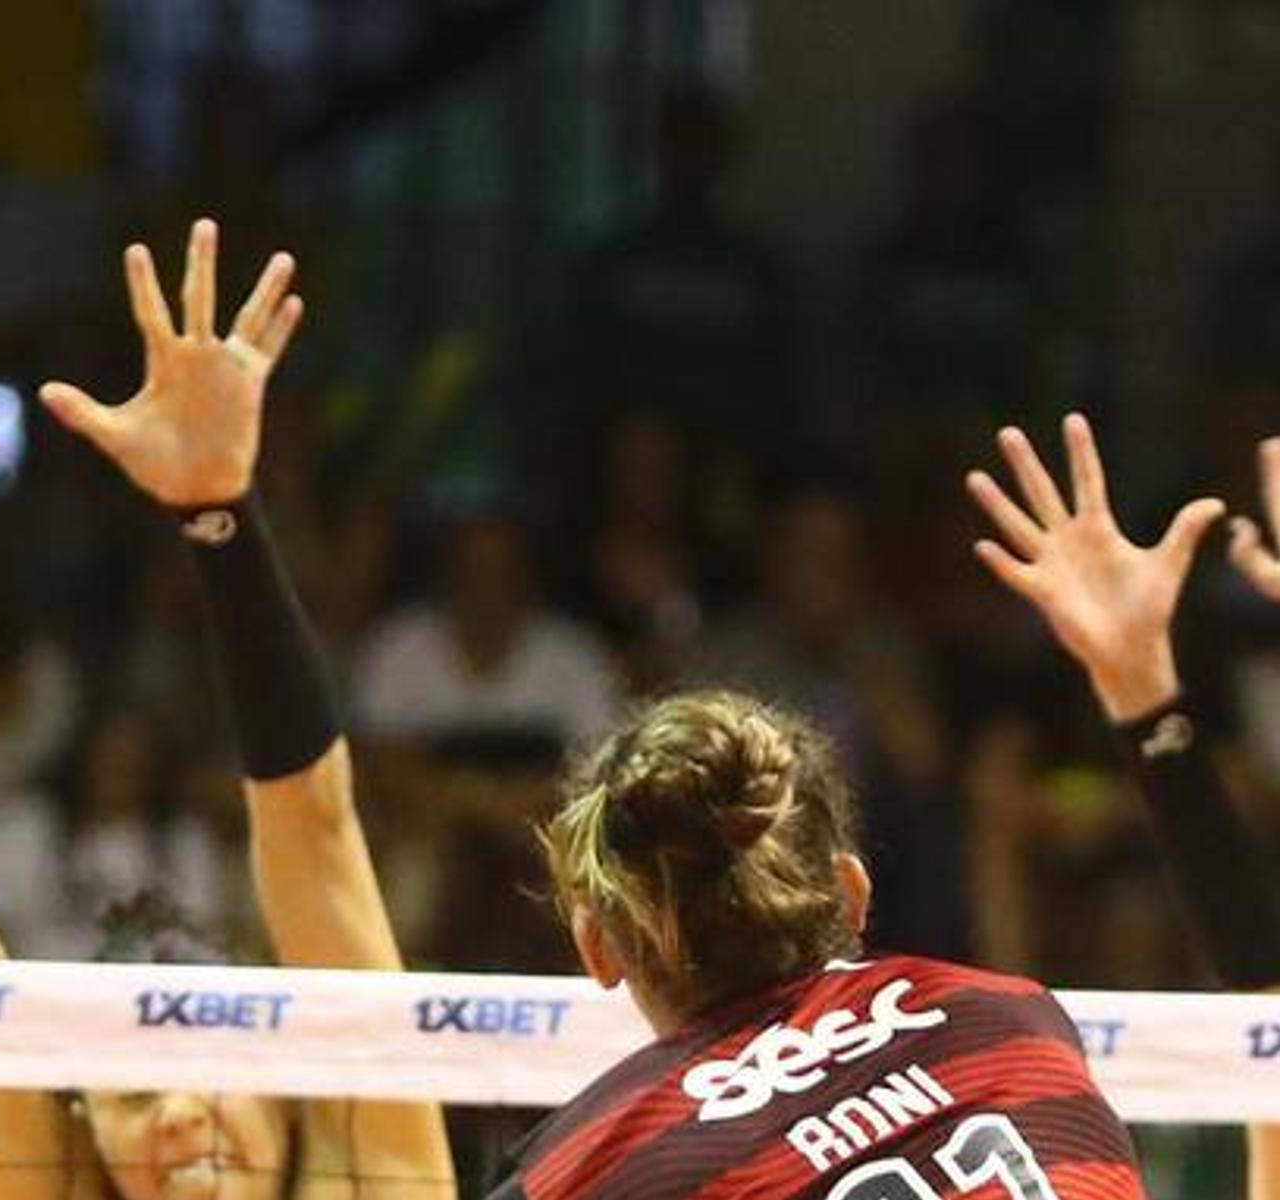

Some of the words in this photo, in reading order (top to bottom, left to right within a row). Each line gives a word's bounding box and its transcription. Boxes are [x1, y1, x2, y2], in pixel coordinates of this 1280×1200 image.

[134, 990, 292, 1031] 1XBET
[413, 996, 570, 1036] 1XBET
[786, 1063, 956, 1174] RONI
